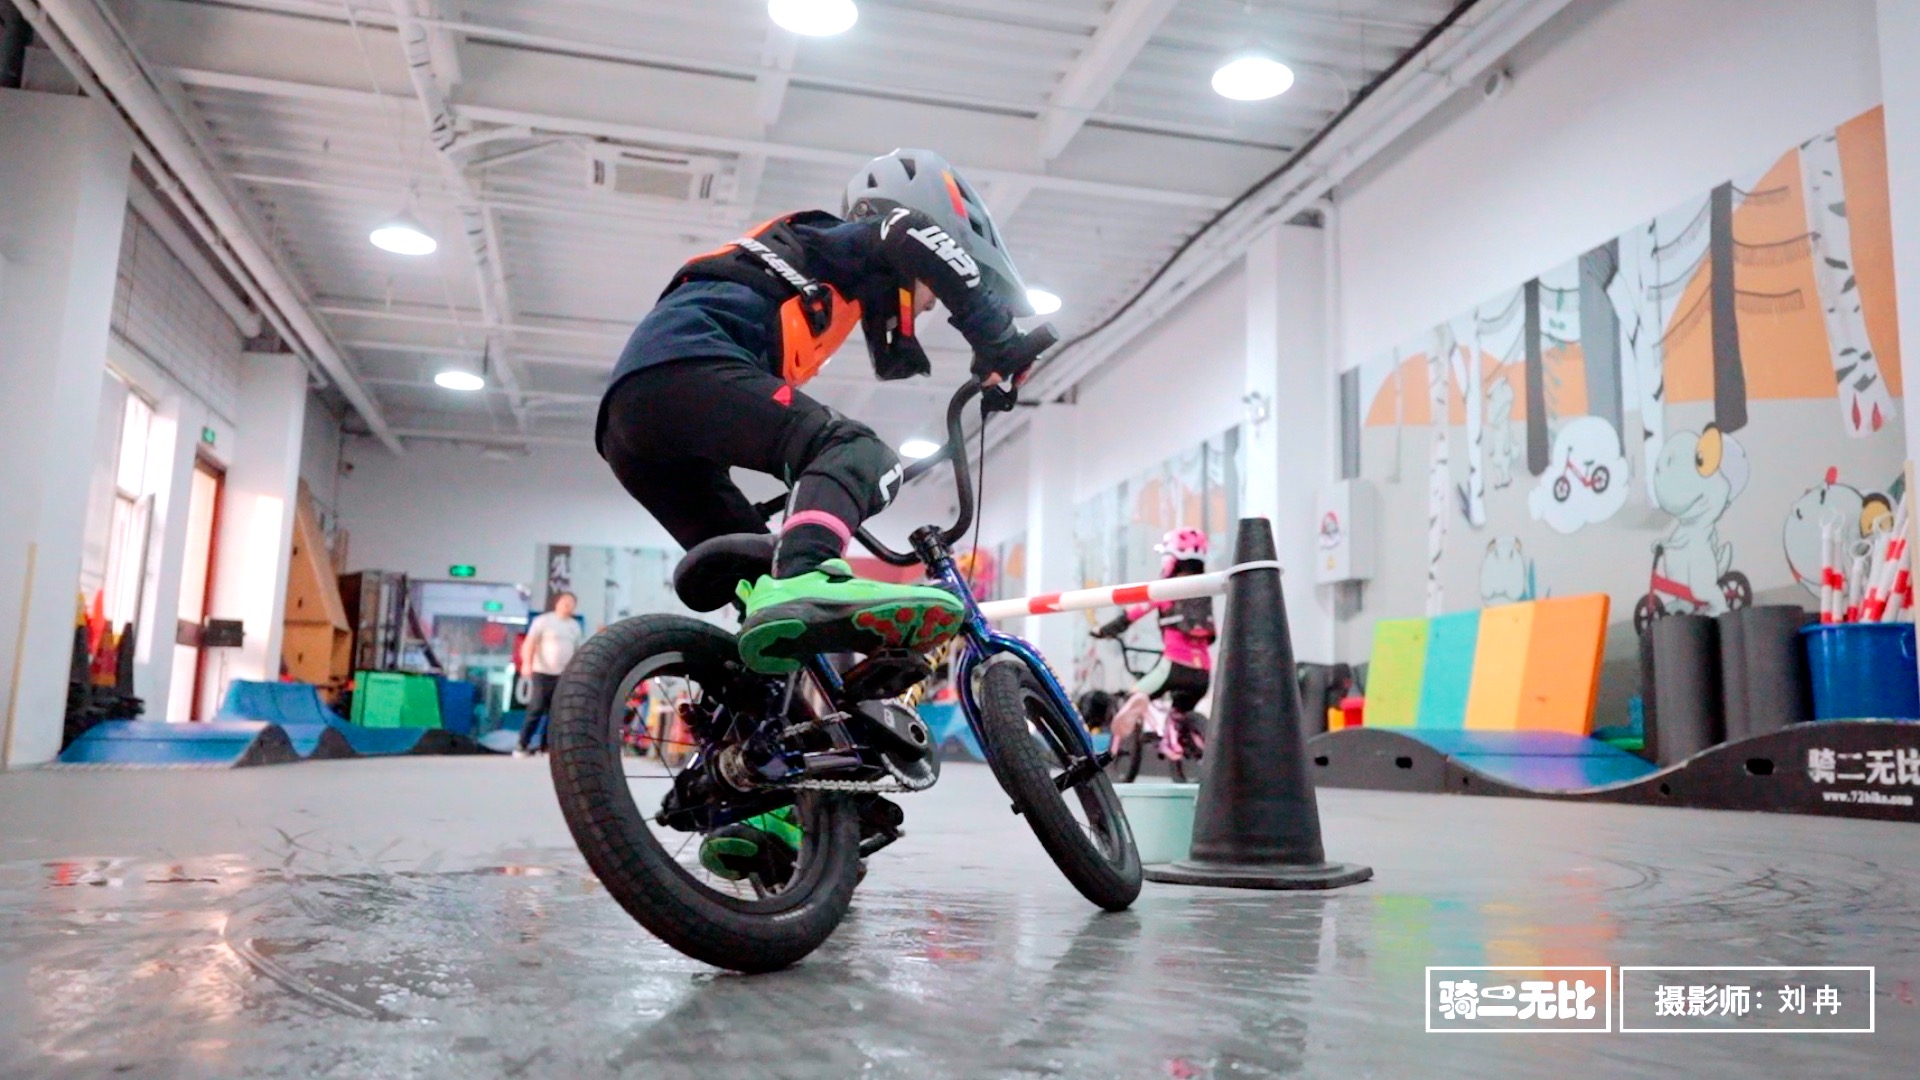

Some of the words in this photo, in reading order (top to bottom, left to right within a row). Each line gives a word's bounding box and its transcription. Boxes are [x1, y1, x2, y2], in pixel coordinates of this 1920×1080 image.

[906, 225, 981, 289] LEATT
[1807, 748, 1920, 785] 骑二无比
